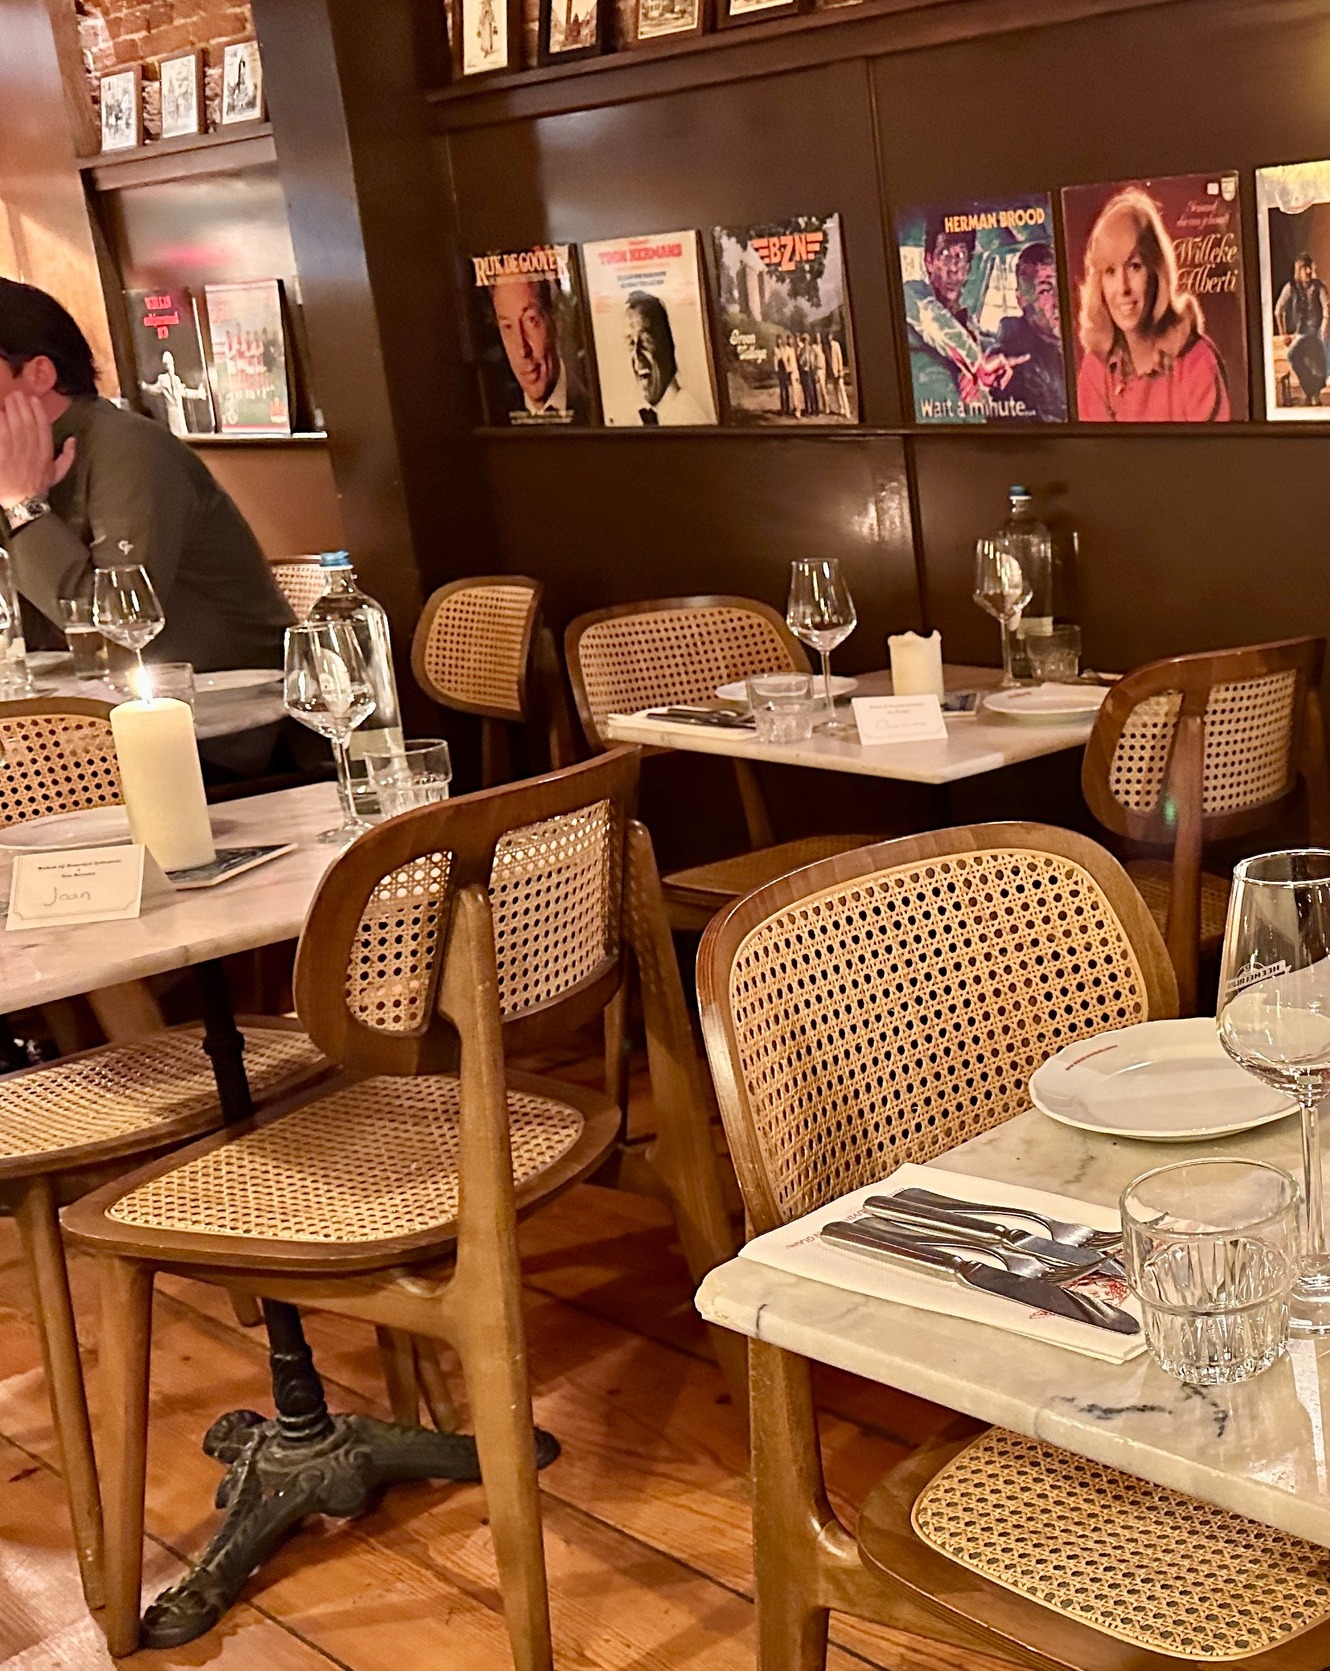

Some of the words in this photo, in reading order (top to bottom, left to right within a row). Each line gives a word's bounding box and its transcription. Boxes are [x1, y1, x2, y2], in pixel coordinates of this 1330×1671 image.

[944, 212, 998, 233] HERMAN
[999, 207, 1045, 228] BROOD
[767, 232, 809, 271] BZN
[1172, 233, 1238, 265] Willeke
[1176, 264, 1239, 293] Alberti
[920, 397, 954, 418] Wait
[957, 401, 966, 417] a
